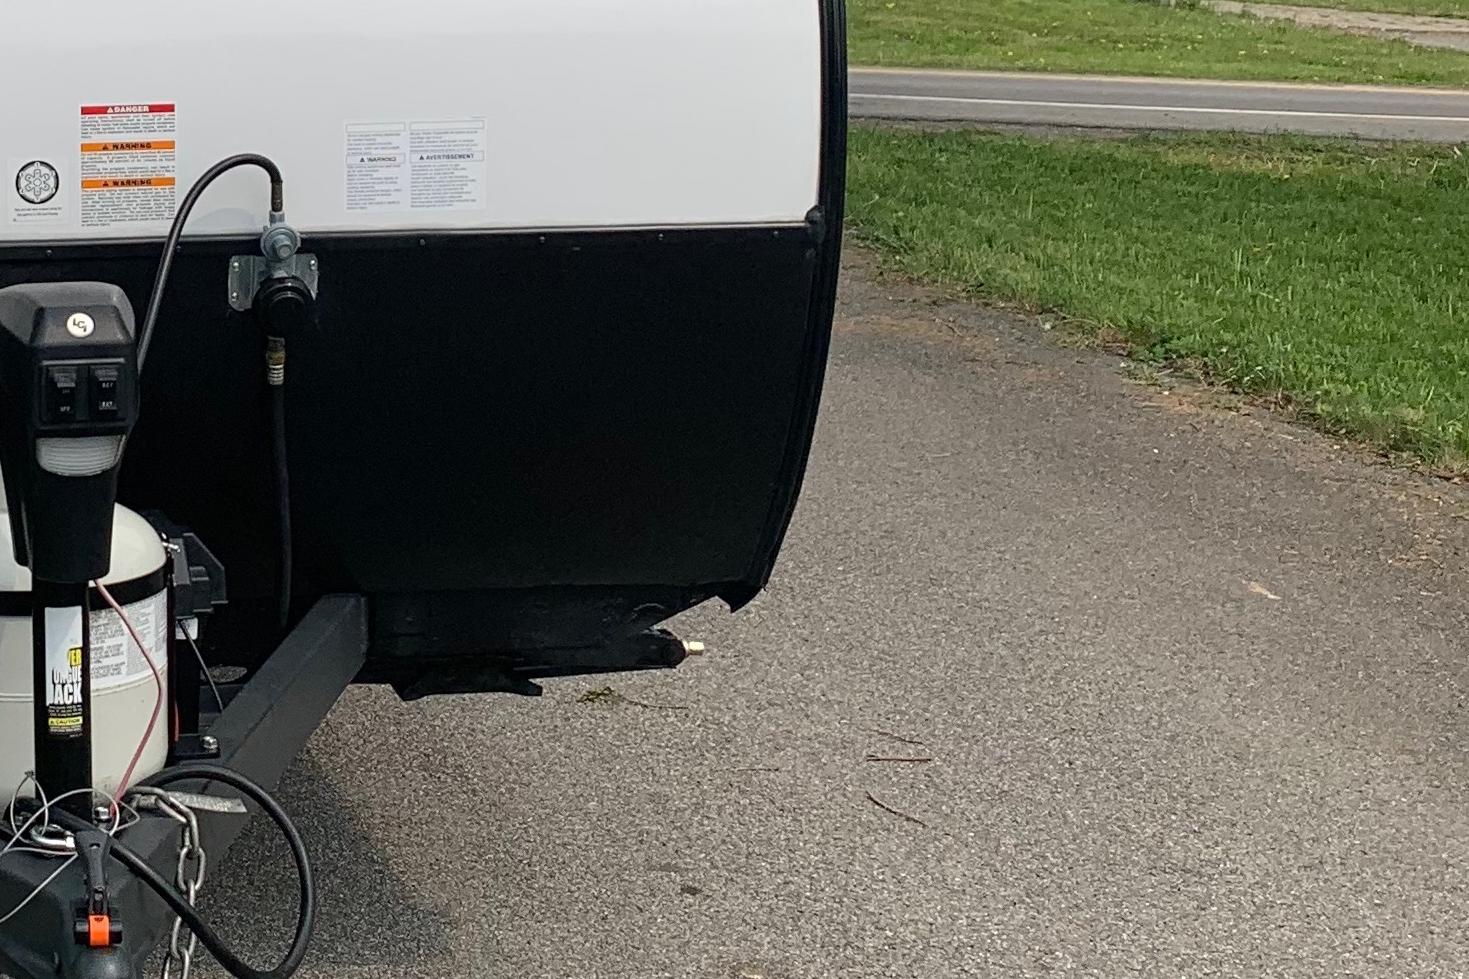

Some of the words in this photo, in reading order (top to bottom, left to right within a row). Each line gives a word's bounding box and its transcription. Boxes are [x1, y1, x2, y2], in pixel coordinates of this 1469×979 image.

[114, 105, 150, 113] DANGER
[112, 142, 152, 150] WARNING
[425, 153, 475, 161] AVERTISSEMENT
